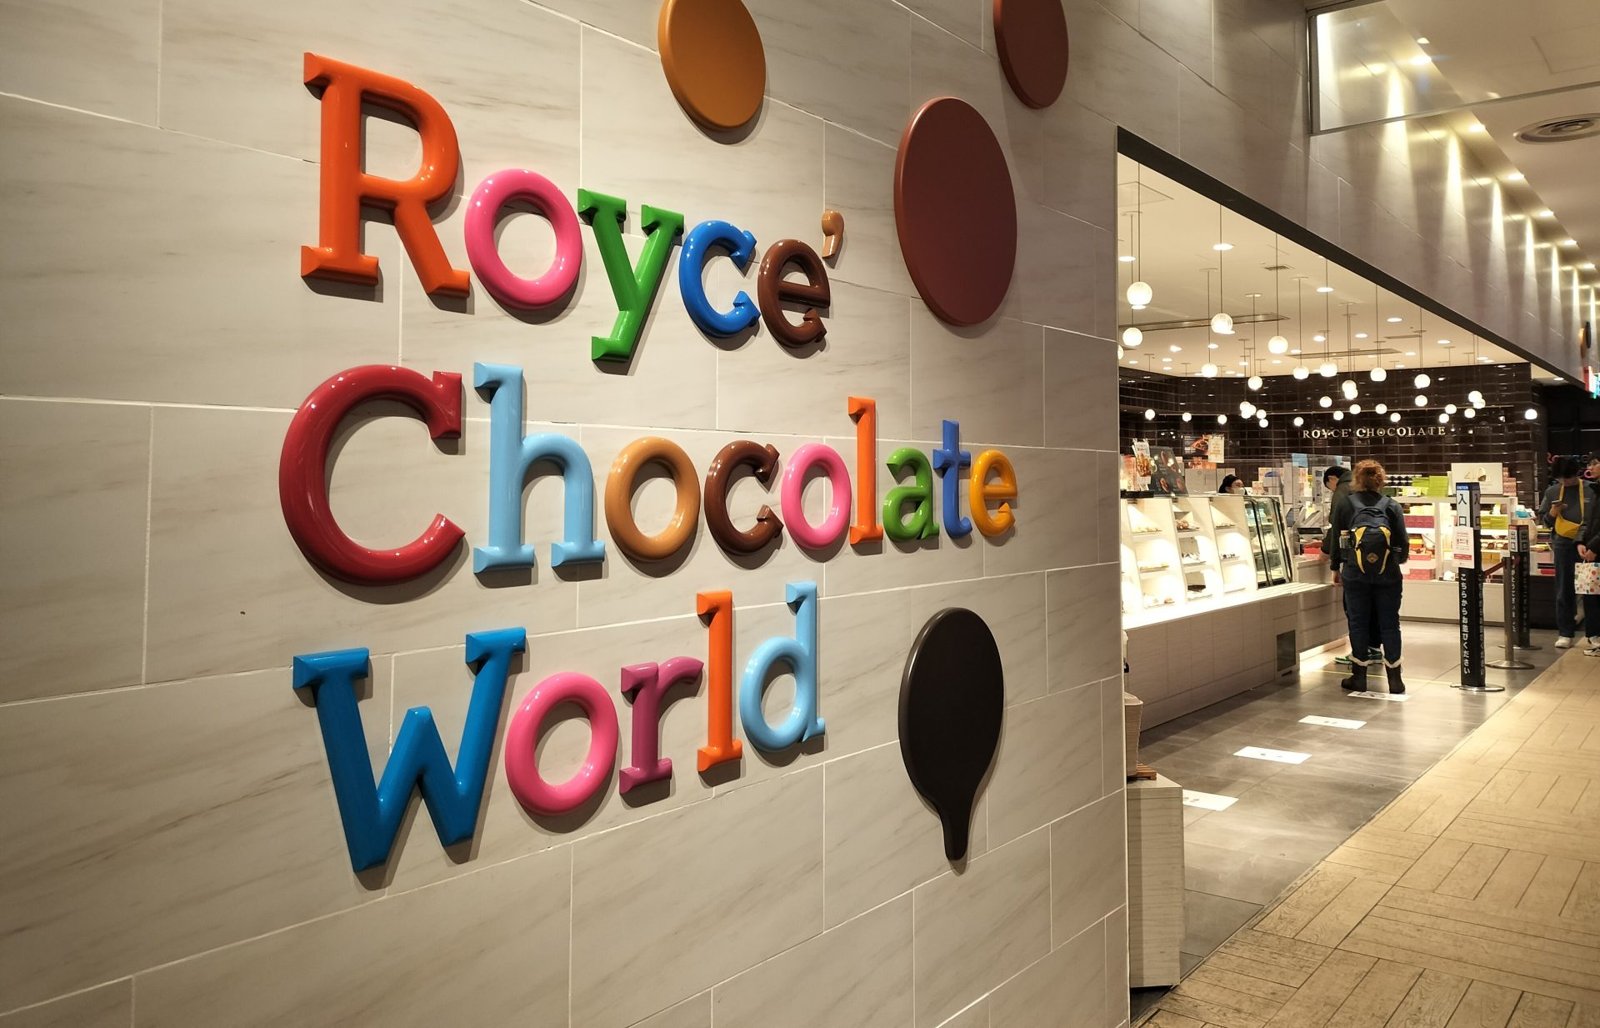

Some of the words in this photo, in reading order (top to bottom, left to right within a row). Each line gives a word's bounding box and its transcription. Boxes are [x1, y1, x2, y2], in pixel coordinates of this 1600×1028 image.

[300, 51, 845, 362] Royce'
[279, 362, 1019, 586] Chocolate
[1303, 428, 1352, 439] ROYCE'
[1356, 426, 1447, 438] CHOCOLATE
[1458, 493, 1467, 526] 入口
[293, 581, 826, 872] World
